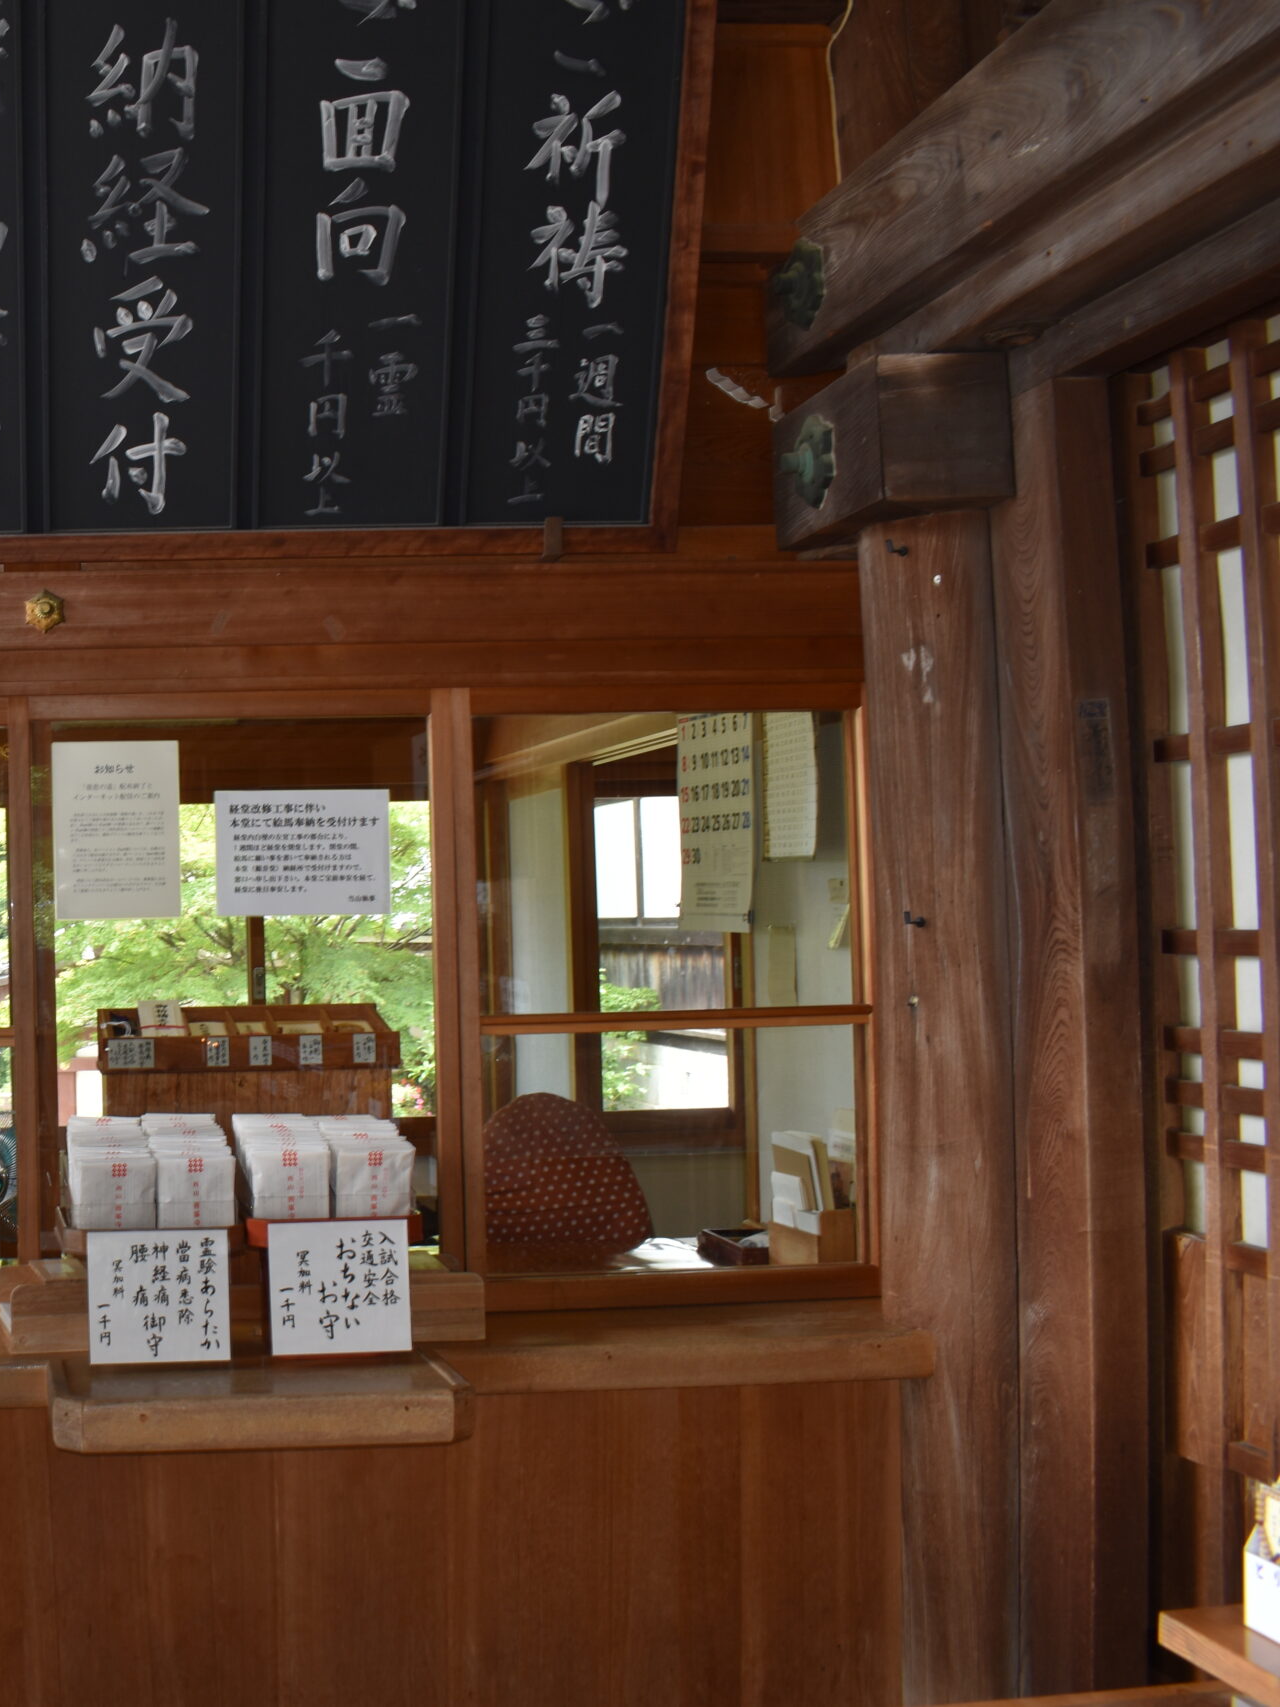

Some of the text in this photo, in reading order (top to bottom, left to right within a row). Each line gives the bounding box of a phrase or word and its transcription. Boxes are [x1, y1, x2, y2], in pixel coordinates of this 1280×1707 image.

[80, 17, 210, 515] 納経受付
[298, 328, 354, 517] 千円以上
[507, 313, 561, 505] 三千円以上
[568, 322, 624, 465] 一週間
[94, 763, 135, 775] お知らせ
[229, 803, 326, 815] 経堂改修工事に伴い
[229, 816, 380, 829] 本堂にて絵馬奉納を受付けます
[112, 1259, 125, 1299] 冥加料
[198, 1237, 220, 1350] 霊験あらたか
[296, 1250, 312, 1295] 冥加料
[336, 1237, 361, 1330] おちない
[360, 1230, 380, 1306] 交通安全
[378, 1231, 401, 1306] 入試合格
[97, 1303, 111, 1347] 一千円
[279, 1287, 295, 1328] 一千円
